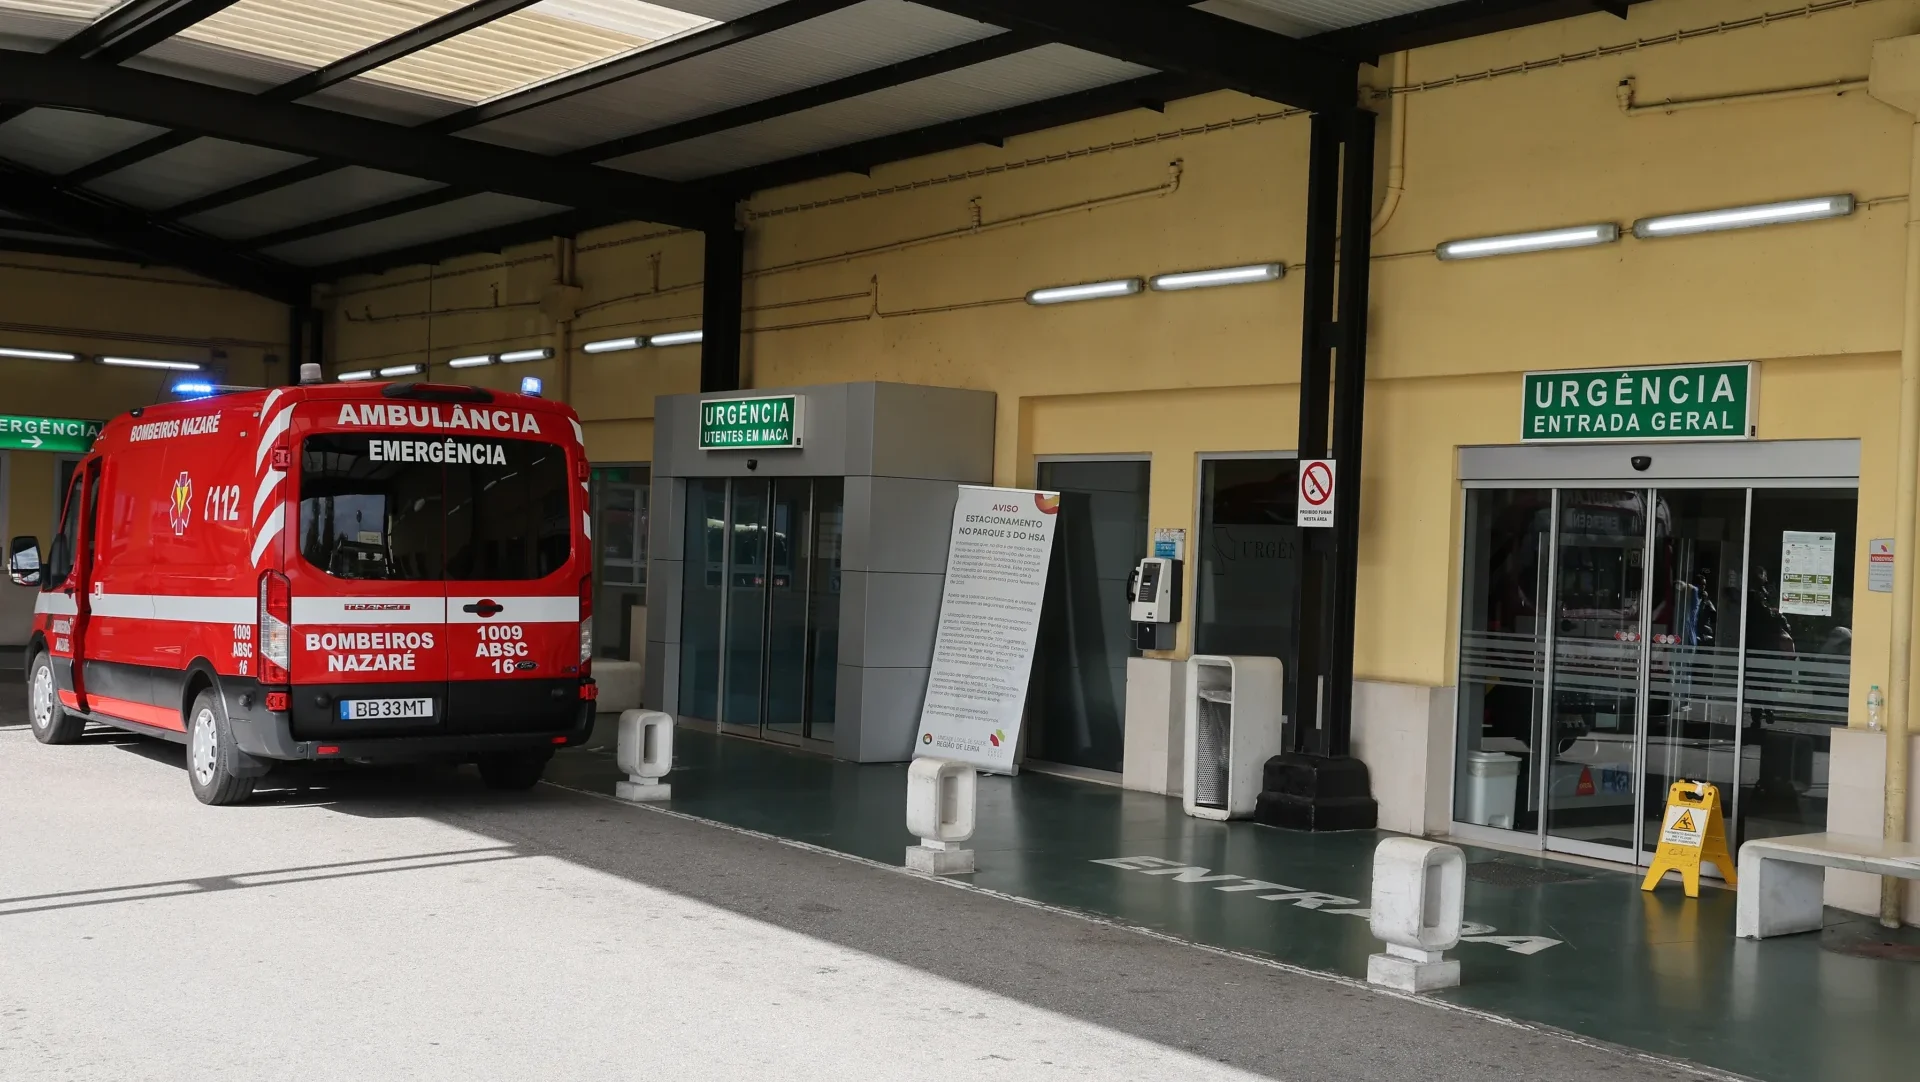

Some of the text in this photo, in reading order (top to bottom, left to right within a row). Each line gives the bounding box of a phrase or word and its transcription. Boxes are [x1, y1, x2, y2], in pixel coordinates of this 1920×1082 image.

[1535, 373, 1735, 408] URGÊNCIA
[338, 404, 540, 434] AMBULÂNCIA
[705, 401, 789, 426] URGÊNCIA
[1534, 410, 1734, 433] ENTRADA GERAL
[130, 410, 221, 442] BOMBEIROS NAZARÉ
[704, 427, 789, 443] UTENTES EM MACA
[369, 438, 506, 465] EMERGÊNCIA
[212, 485, 240, 521] 112
[992, 504, 1018, 513] AVISO
[966, 515, 1043, 528] ESTACIONAMENTO
[972, 528, 1005, 538] PARQUE
[1028, 534, 1046, 542] HSA
[233, 625, 251, 640] 1009
[477, 625, 523, 641] 1009
[306, 632, 434, 651] BOMBEIROS
[475, 642, 529, 657] ABSC
[233, 642, 253, 658] ABSC
[239, 660, 248, 675] 16
[328, 650, 416, 672] NAZARÉ
[491, 659, 515, 674] 16
